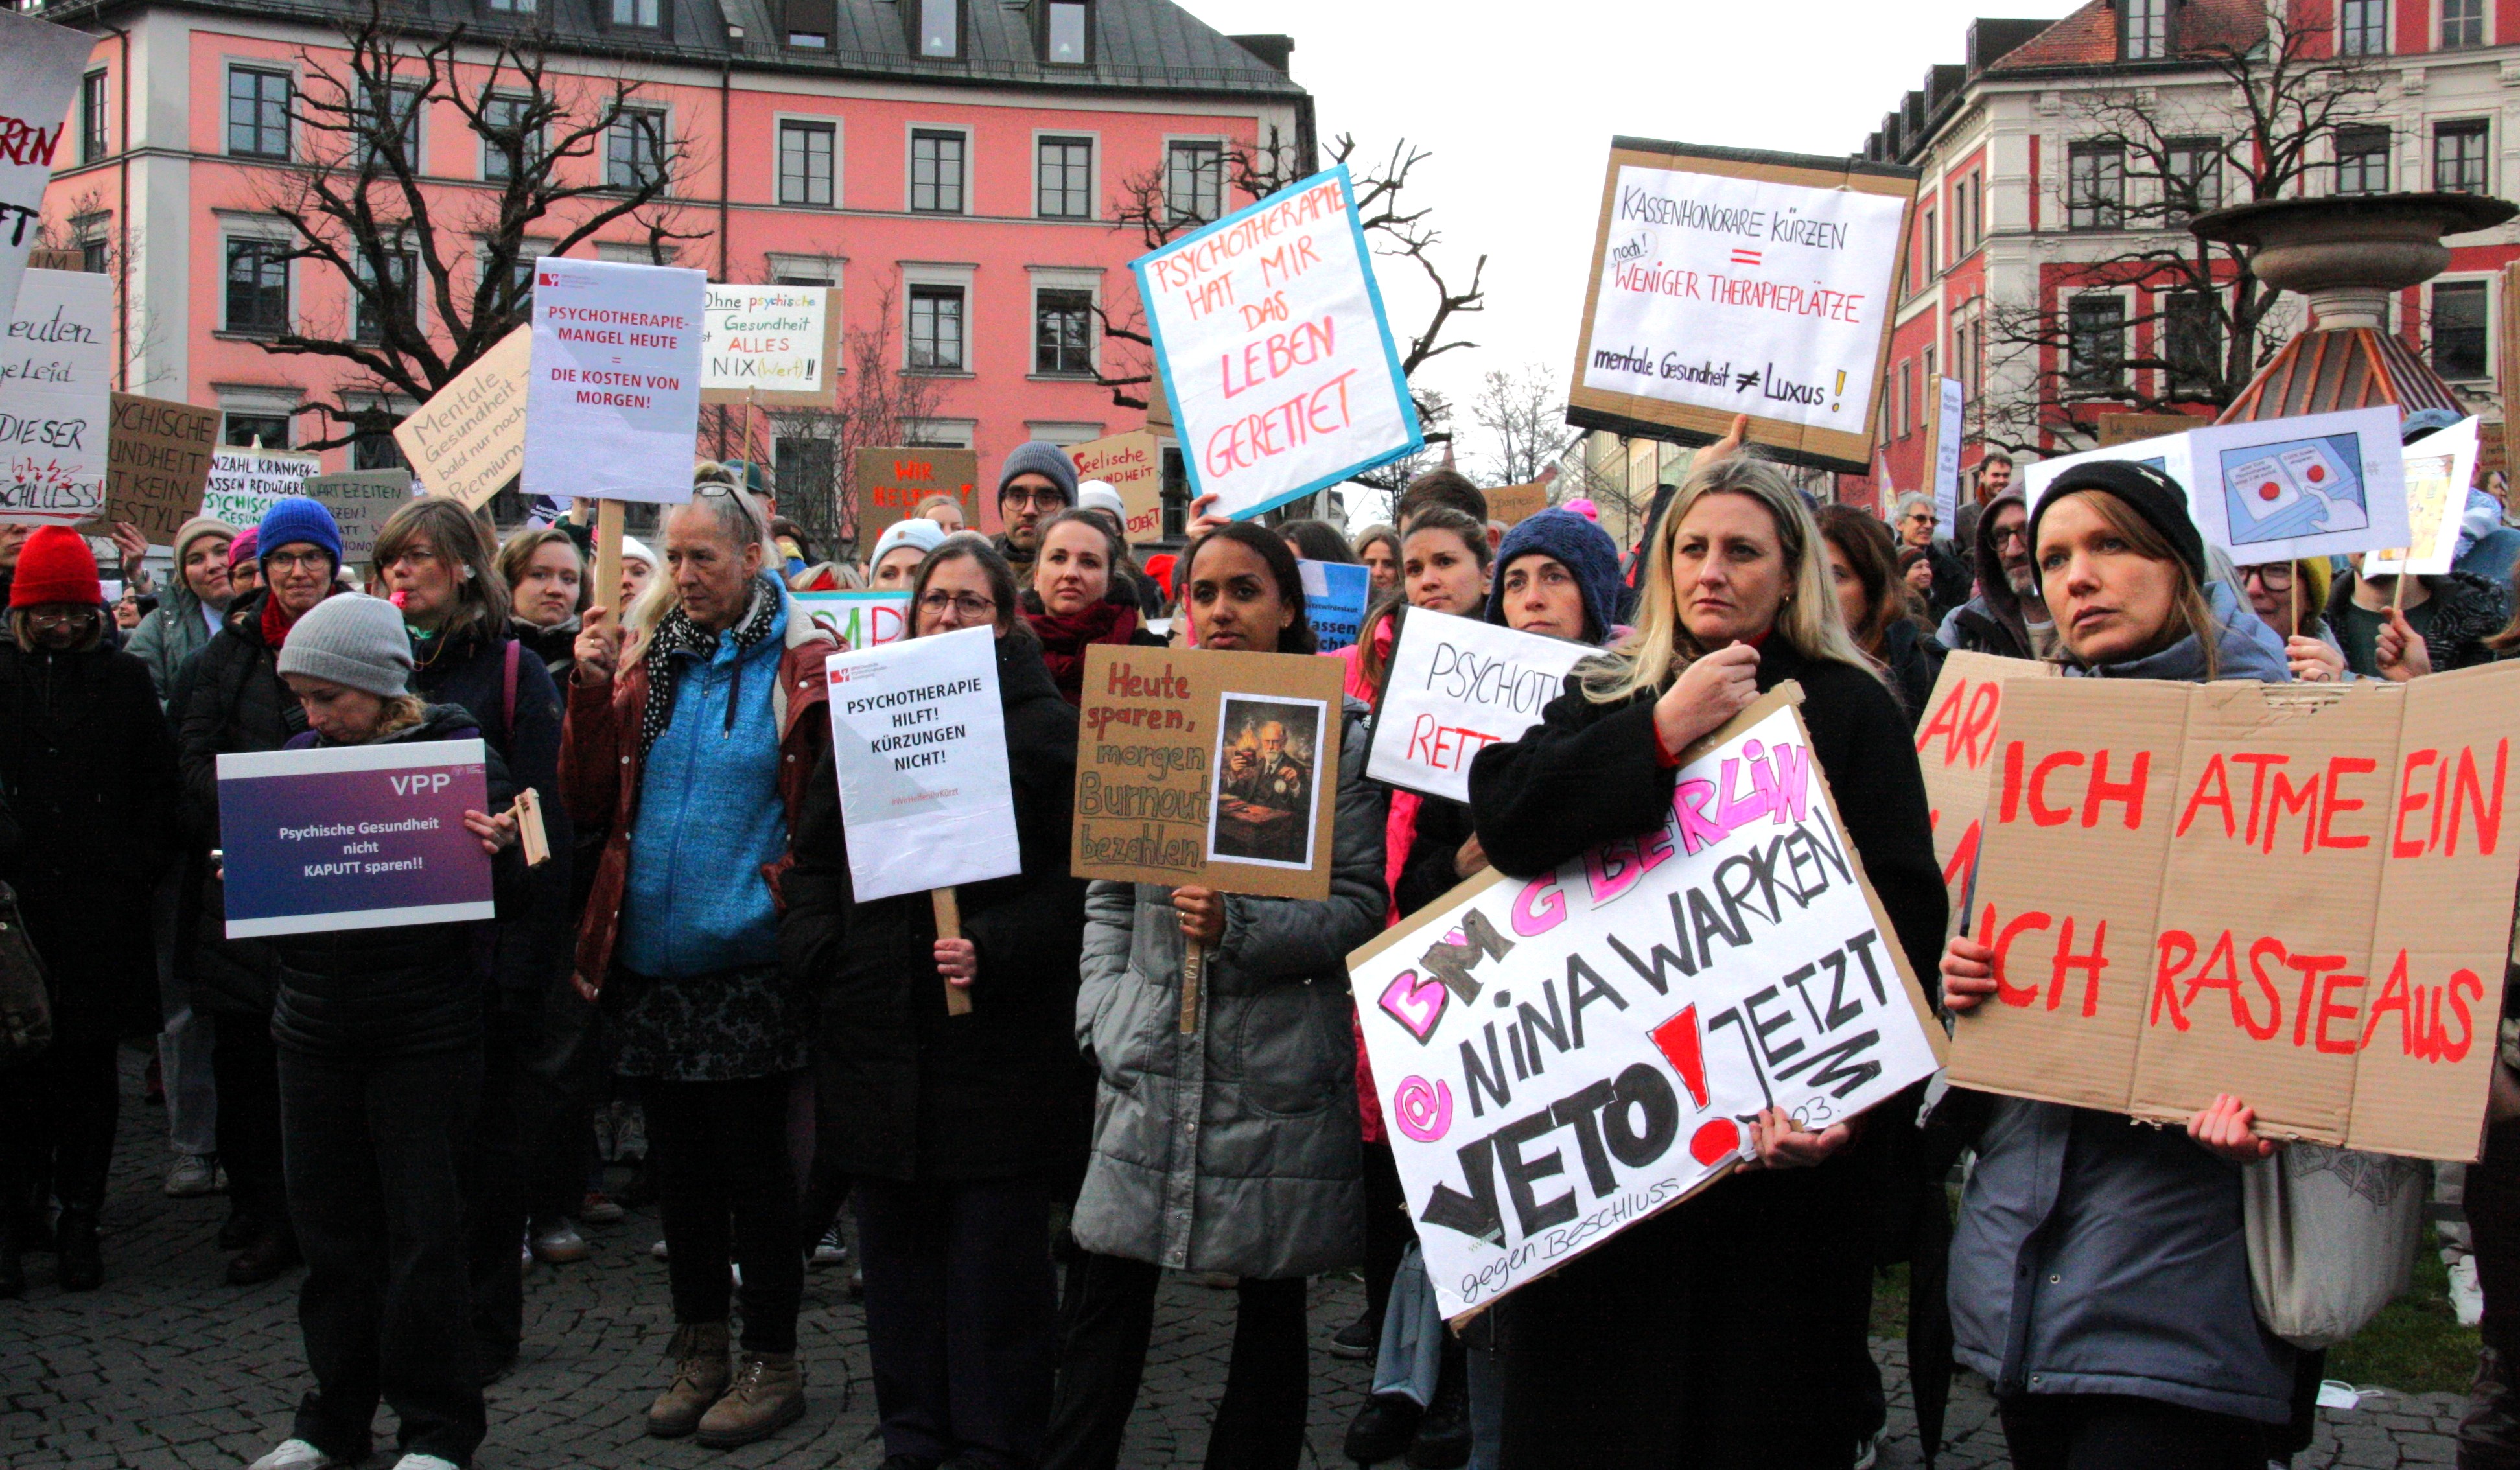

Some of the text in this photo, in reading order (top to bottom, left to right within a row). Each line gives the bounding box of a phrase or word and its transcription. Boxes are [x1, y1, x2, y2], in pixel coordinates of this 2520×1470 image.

[1621, 185, 1848, 251] KASSENHONORARE KÜRZEN
[1150, 181, 1349, 293] PSYCHOTHERAPIE
[1613, 233, 1648, 261] noch!
[1185, 235, 1323, 321] HAT MIR
[749, 293, 816, 313] psychische
[1239, 290, 1289, 333] DAS
[1707, 275, 1865, 324] THERAPIEPLÄTZE
[8, 305, 102, 344] euten
[548, 306, 690, 330] PSYCHOTHERAPIE-
[725, 314, 810, 331] Gesundheit
[558, 327, 677, 349] MANGEL HEUTE
[728, 337, 789, 353] ALLES
[1221, 314, 1335, 400] LEBEN
[1594, 345, 1655, 378] mentale
[1659, 351, 1732, 388] Gesundheit
[552, 368, 679, 390] DIE KOSTEN VON
[414, 373, 499, 445] Mentale
[576, 390, 651, 408] MORGEN!
[111, 400, 213, 443] YCHISCHE
[426, 379, 517, 463] Gesundheit
[1206, 368, 1359, 479] GERETTET
[109, 439, 204, 474] UNDHEIT
[438, 405, 526, 482] bald nur noch
[212, 456, 318, 477] NZAHL KRANKEN-
[1073, 447, 1148, 477] Seelische
[133, 474, 193, 503] KEIN
[207, 477, 307, 496] ASSEN REDUZIERE
[309, 484, 401, 499] WARTEZEITEN
[217, 511, 262, 526] GESUN
[1126, 508, 1160, 533] OJEKT
[1309, 619, 1357, 635] assen
[1320, 637, 1347, 651] cht
[846, 678, 983, 714] PSYCHOTHERAPIE
[1108, 662, 1191, 699] Heute
[1427, 642, 1558, 716] PSYCHOT
[892, 708, 939, 728] HILFT!
[1086, 706, 1196, 741] sparen,
[871, 725, 966, 753] KÜRZUNGEN
[894, 751, 947, 771] NICHT!
[1096, 743, 1206, 782] morgen
[390, 773, 452, 797] VPP
[1079, 771, 1212, 821] Burnout
[1998, 737, 2508, 859] ICH ATME EIN
[279, 817, 439, 841] Psychische Gesundheit
[1080, 823, 1208, 869] bezahlen.
[343, 841, 379, 856] nicht
[303, 857, 423, 878] KAPUTT sparen!!
[1607, 804, 1855, 997] WARKEN
[2149, 928, 2370, 1055] RASTE
[1708, 928, 1890, 1125] JETZT
[1461, 1243, 1536, 1304] gegen
